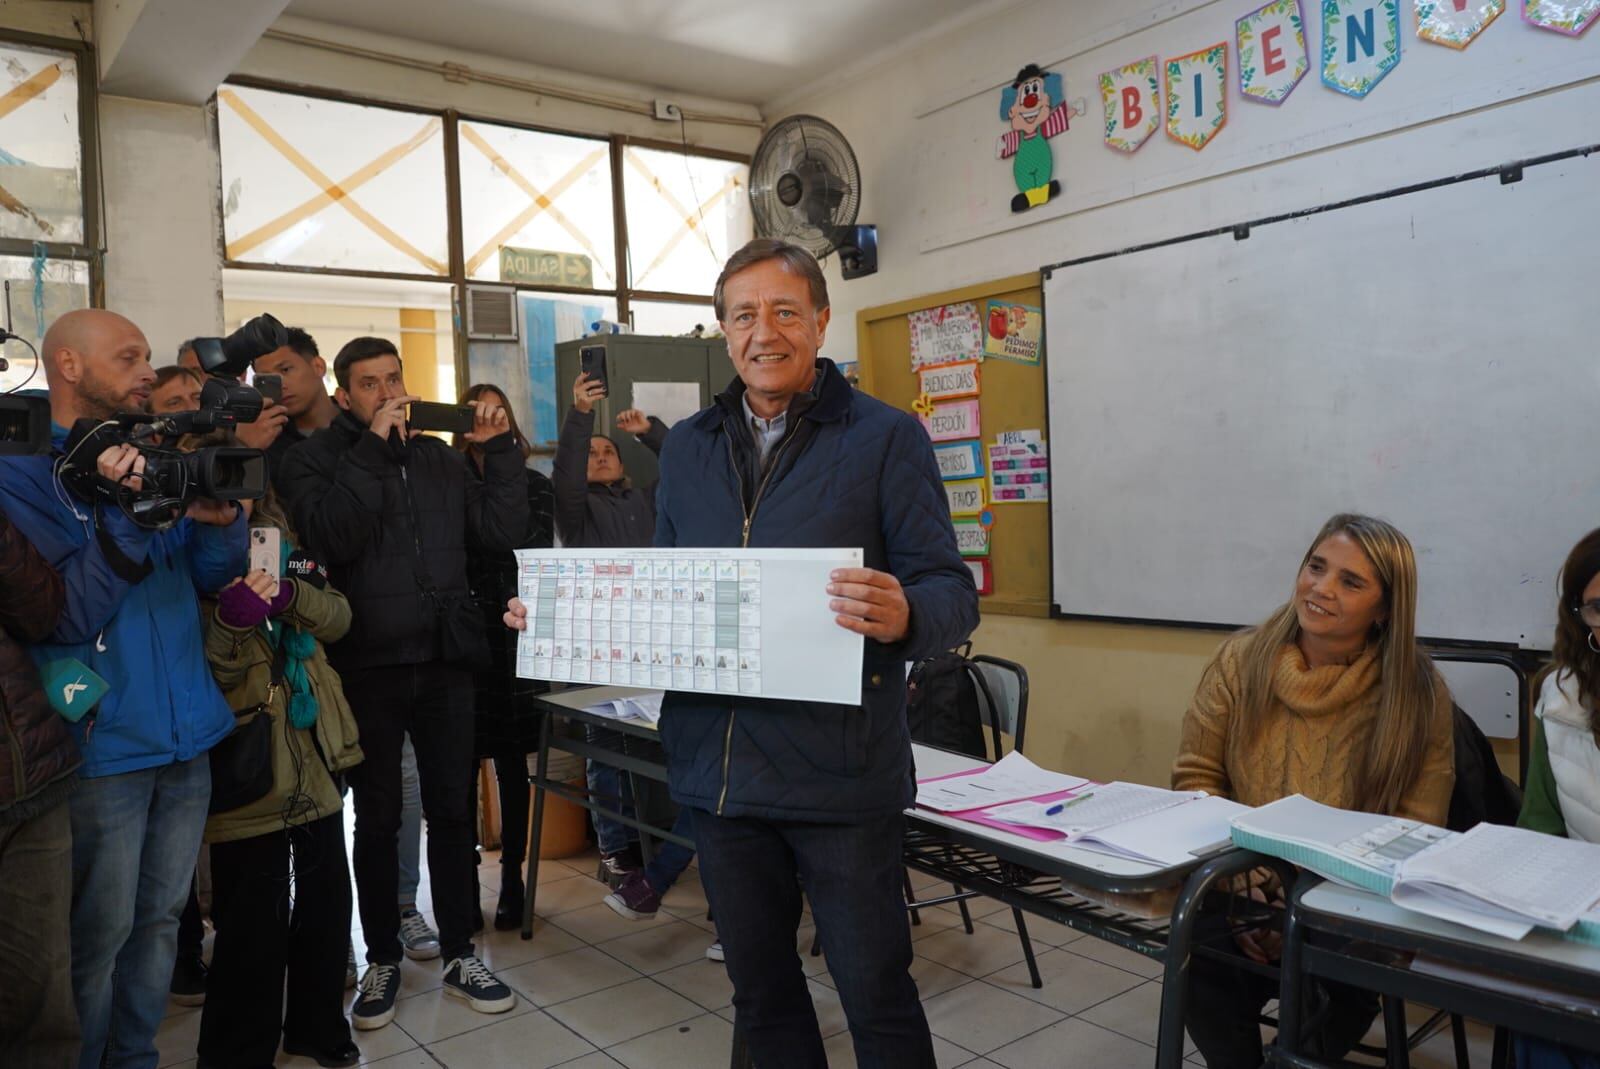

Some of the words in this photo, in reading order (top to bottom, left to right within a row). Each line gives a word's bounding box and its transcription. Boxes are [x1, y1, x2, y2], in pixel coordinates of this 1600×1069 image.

[1004, 345, 1037, 358] PERMISO
[1005, 336, 1038, 350] PEDIMOS
[925, 374, 954, 393] BUENOS
[931, 411, 966, 433] PERDÓN
[1004, 431, 1026, 446] ABRIL
[951, 489, 978, 508] FAVOR
